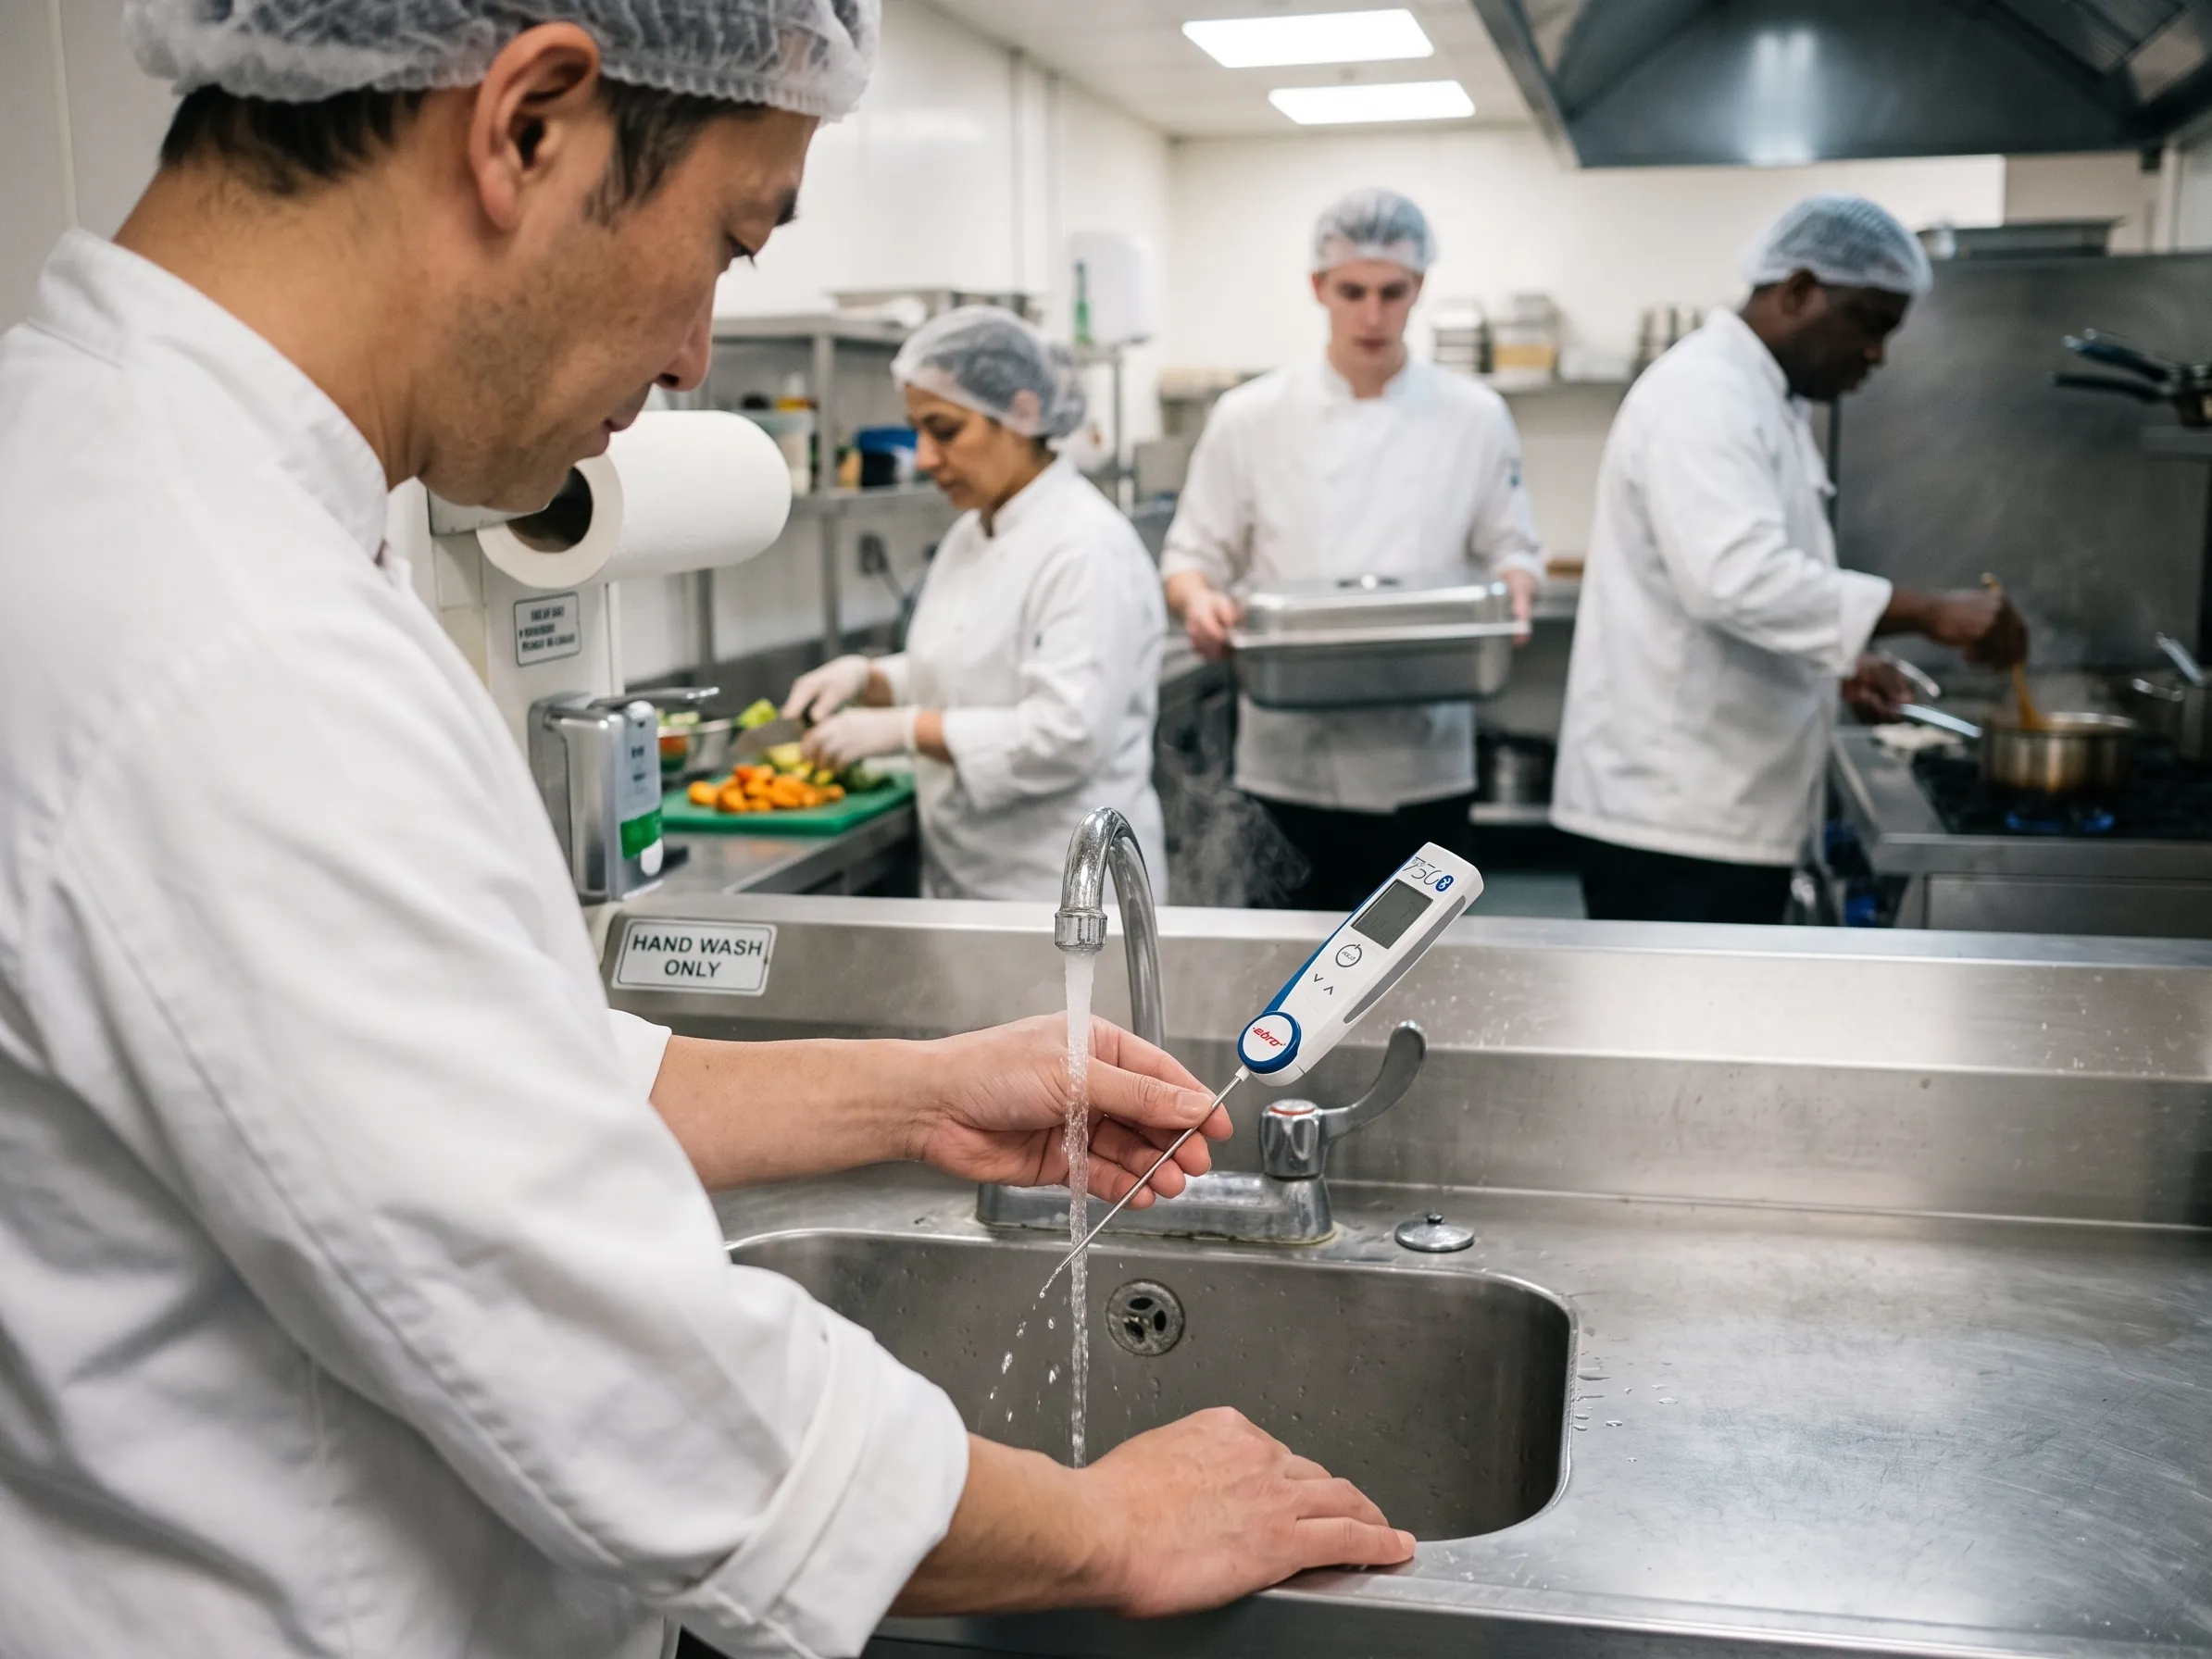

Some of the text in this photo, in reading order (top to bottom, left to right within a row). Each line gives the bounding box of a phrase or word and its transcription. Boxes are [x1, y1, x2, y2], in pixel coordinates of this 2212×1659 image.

[632, 934, 763, 956] HAND WASH
[664, 959, 721, 978] ONLY
[1253, 1028, 1282, 1047] ebro
